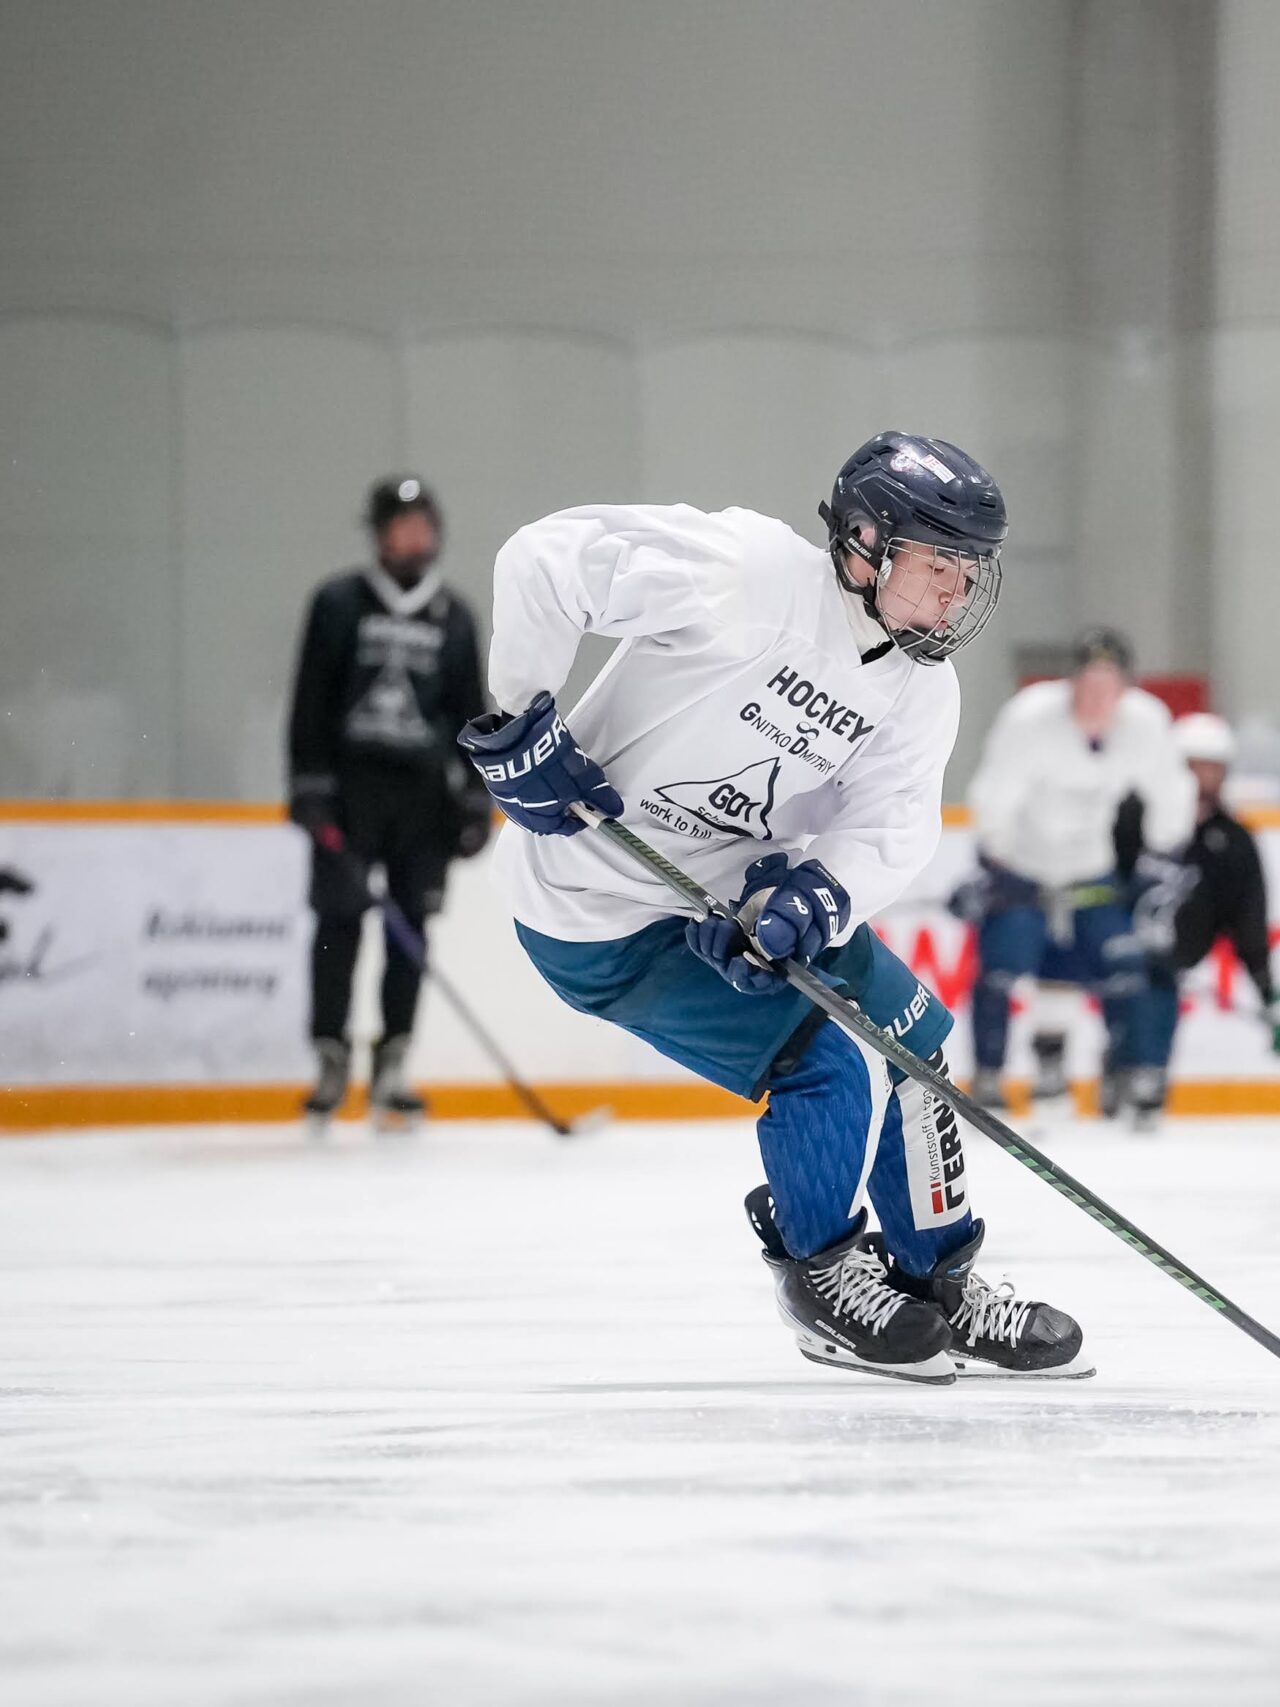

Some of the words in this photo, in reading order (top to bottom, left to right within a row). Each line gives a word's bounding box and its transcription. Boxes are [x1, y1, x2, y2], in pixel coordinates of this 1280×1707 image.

[739, 702, 792, 748] GNITKO
[766, 665, 875, 744] HOCKEY
[639, 799, 674, 824] work
[674, 816, 689, 832] to
[853, 1013, 915, 1060] COVERT
[922, 1123, 941, 1182] Kunststoff
